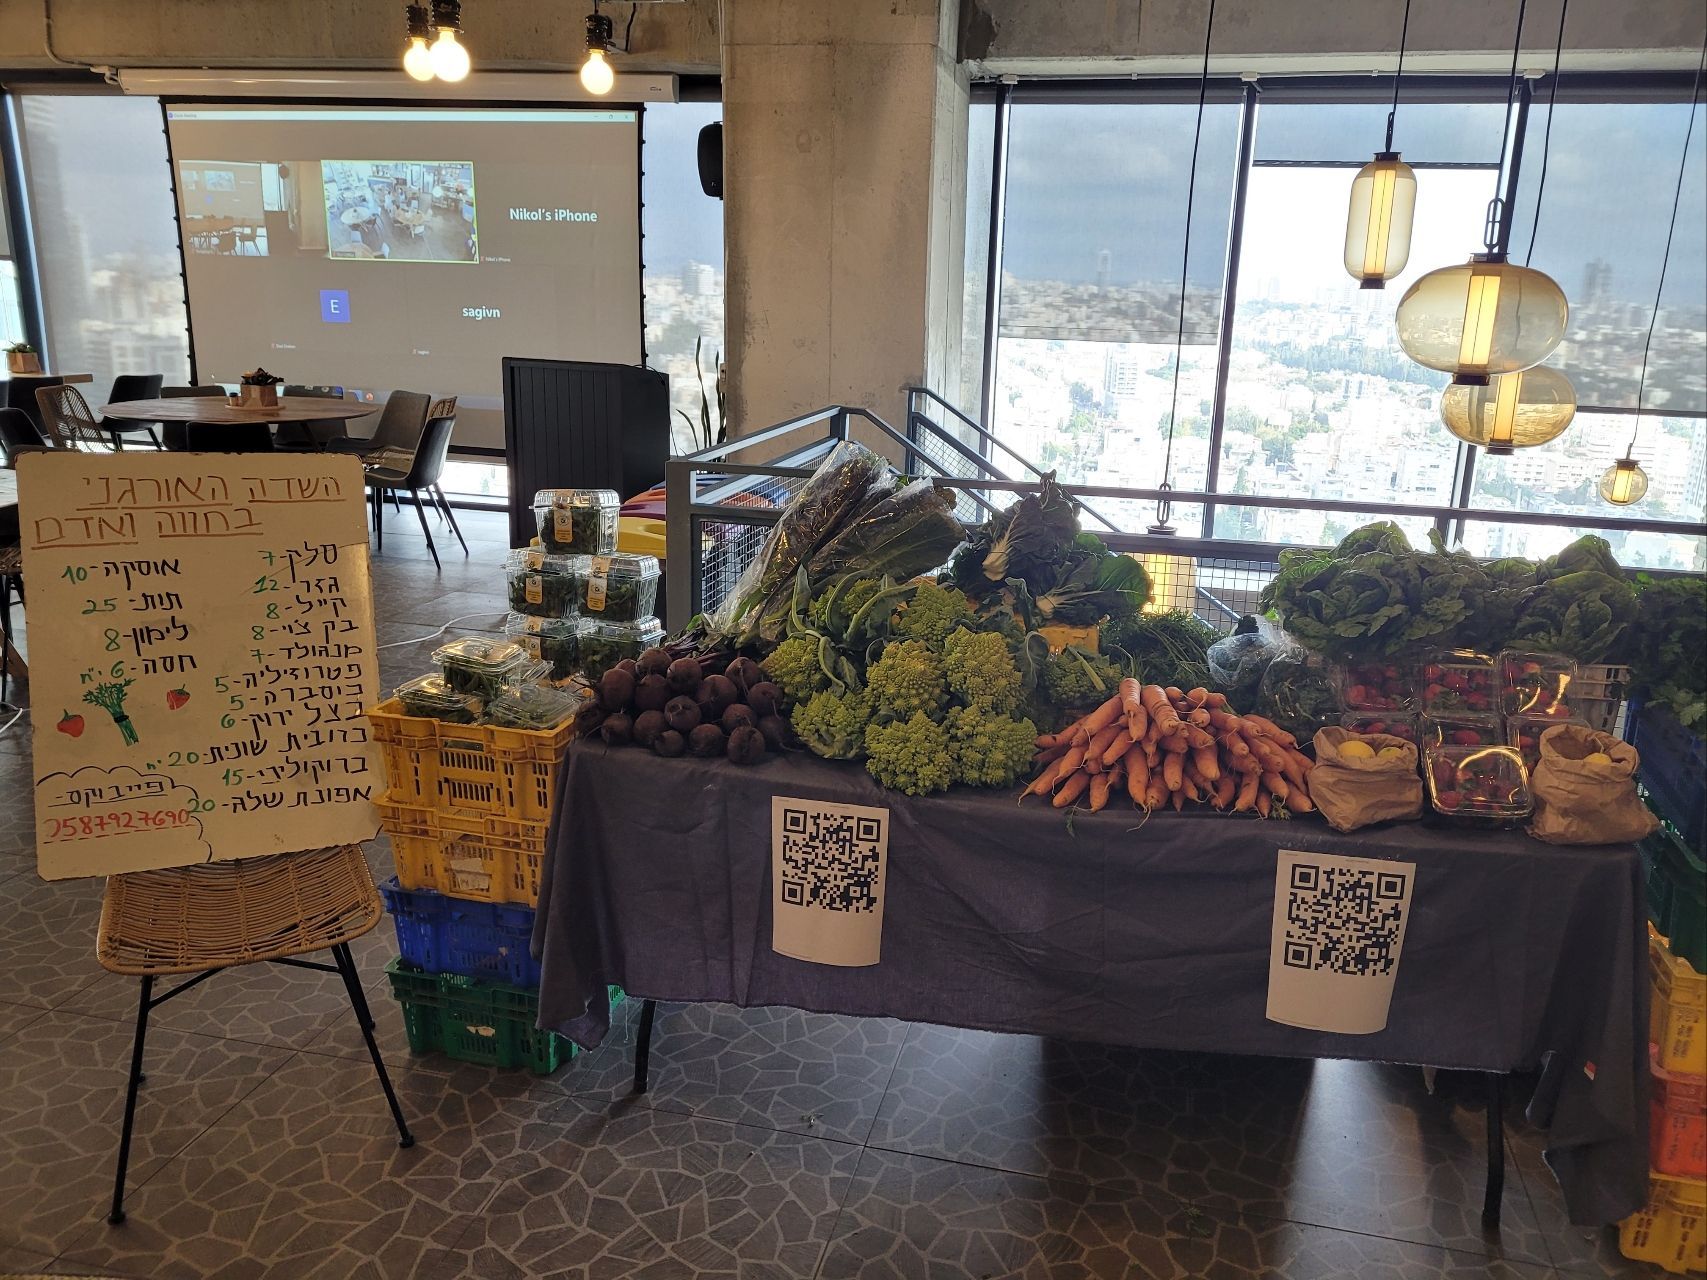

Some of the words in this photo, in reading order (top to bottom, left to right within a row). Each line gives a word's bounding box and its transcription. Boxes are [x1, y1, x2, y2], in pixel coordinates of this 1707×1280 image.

[509, 207, 552, 221] Nikol's
[554, 208, 598, 222] iPhone
[330, 299, 340, 314] E
[462, 305, 501, 321] sagivn
[82, 475, 230, 505] האורגני
[247, 476, 341, 500] השדה
[33, 513, 138, 544] ואדם
[157, 509, 262, 533] בחווה
[307, 701, 366, 727] בצל
[278, 727, 367, 753] כרובית
